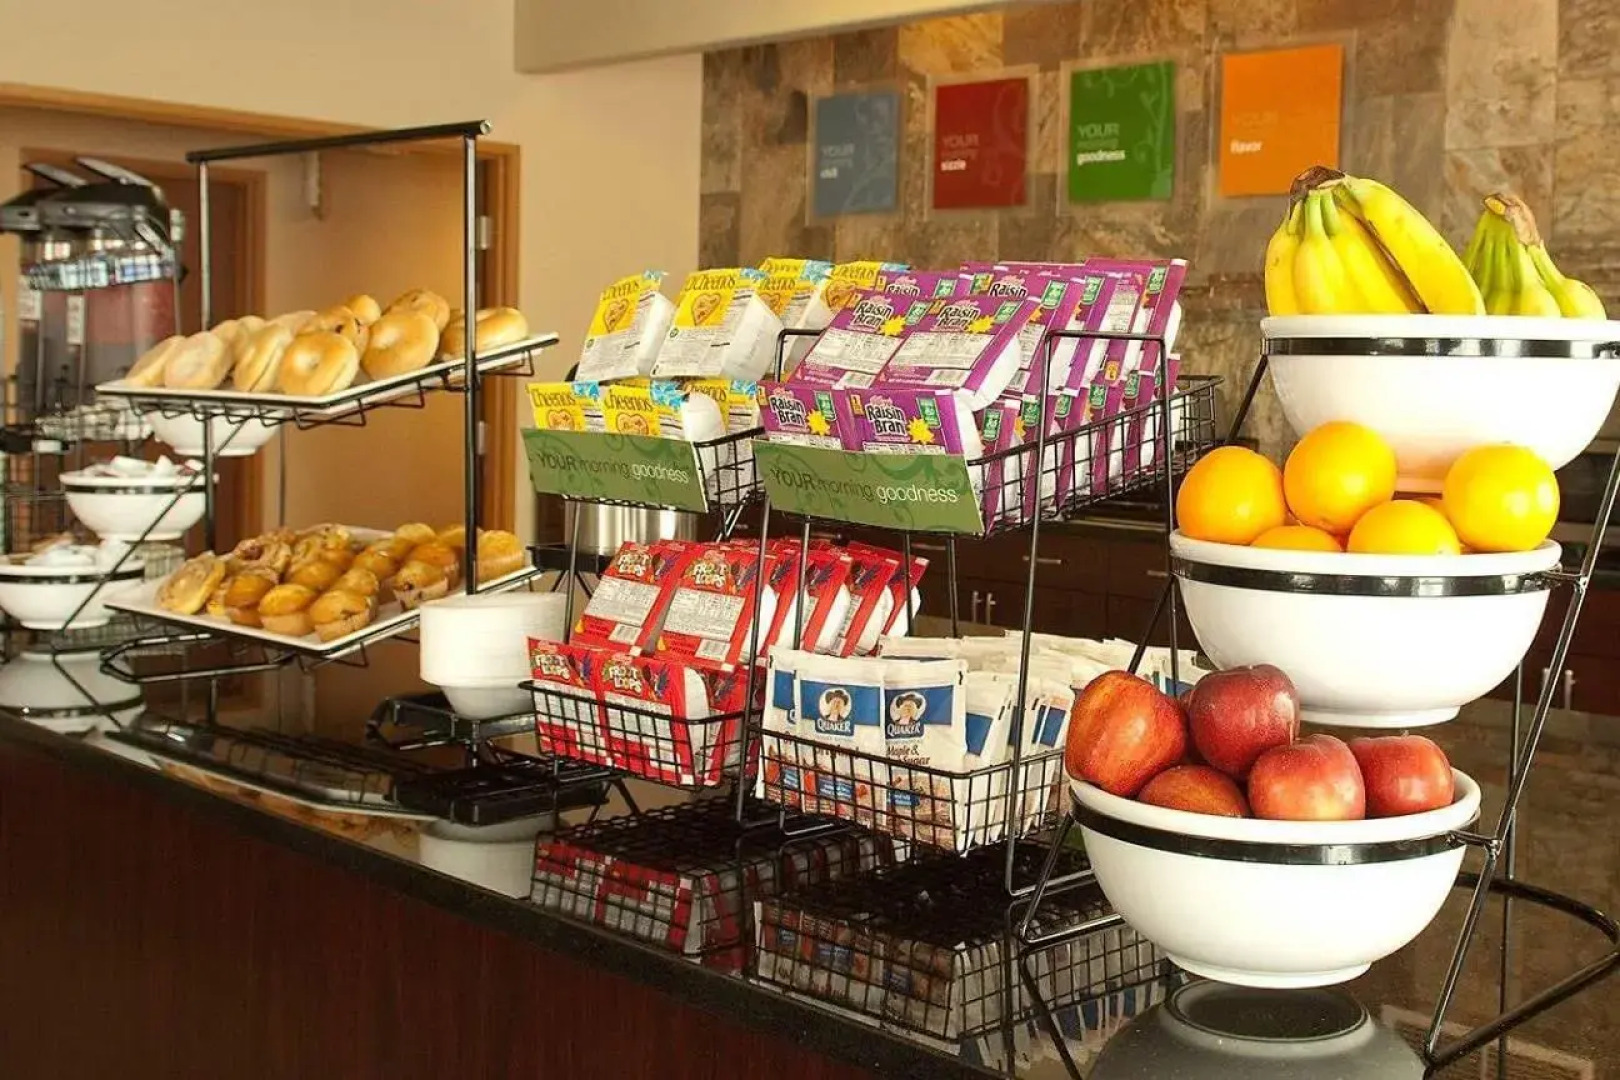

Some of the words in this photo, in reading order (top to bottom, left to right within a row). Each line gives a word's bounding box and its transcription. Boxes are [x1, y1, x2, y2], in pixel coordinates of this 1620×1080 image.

[1077, 122, 1119, 138] YOUR
[942, 134, 979, 148] YOUR
[1077, 149, 1126, 166] goodness
[989, 282, 1028, 297] Raisin
[856, 302, 892, 318] Raisin
[941, 306, 979, 321] Raisin
[531, 388, 576, 408] Cheerios
[604, 390, 653, 412] Cheerios
[770, 396, 804, 415] Raisin
[778, 409, 806, 426] Bran
[867, 404, 905, 420] Raisin
[874, 418, 906, 434] Bran
[538, 453, 577, 472] YOUR
[579, 457, 629, 479] morning
[631, 463, 690, 484] goodness
[771, 464, 816, 491] YOUR
[817, 478, 873, 502] morning
[876, 485, 958, 504] goodness
[817, 719, 851, 732] QUAKER
[886, 723, 921, 737] QUAKER
[911, 745, 919, 756] &
